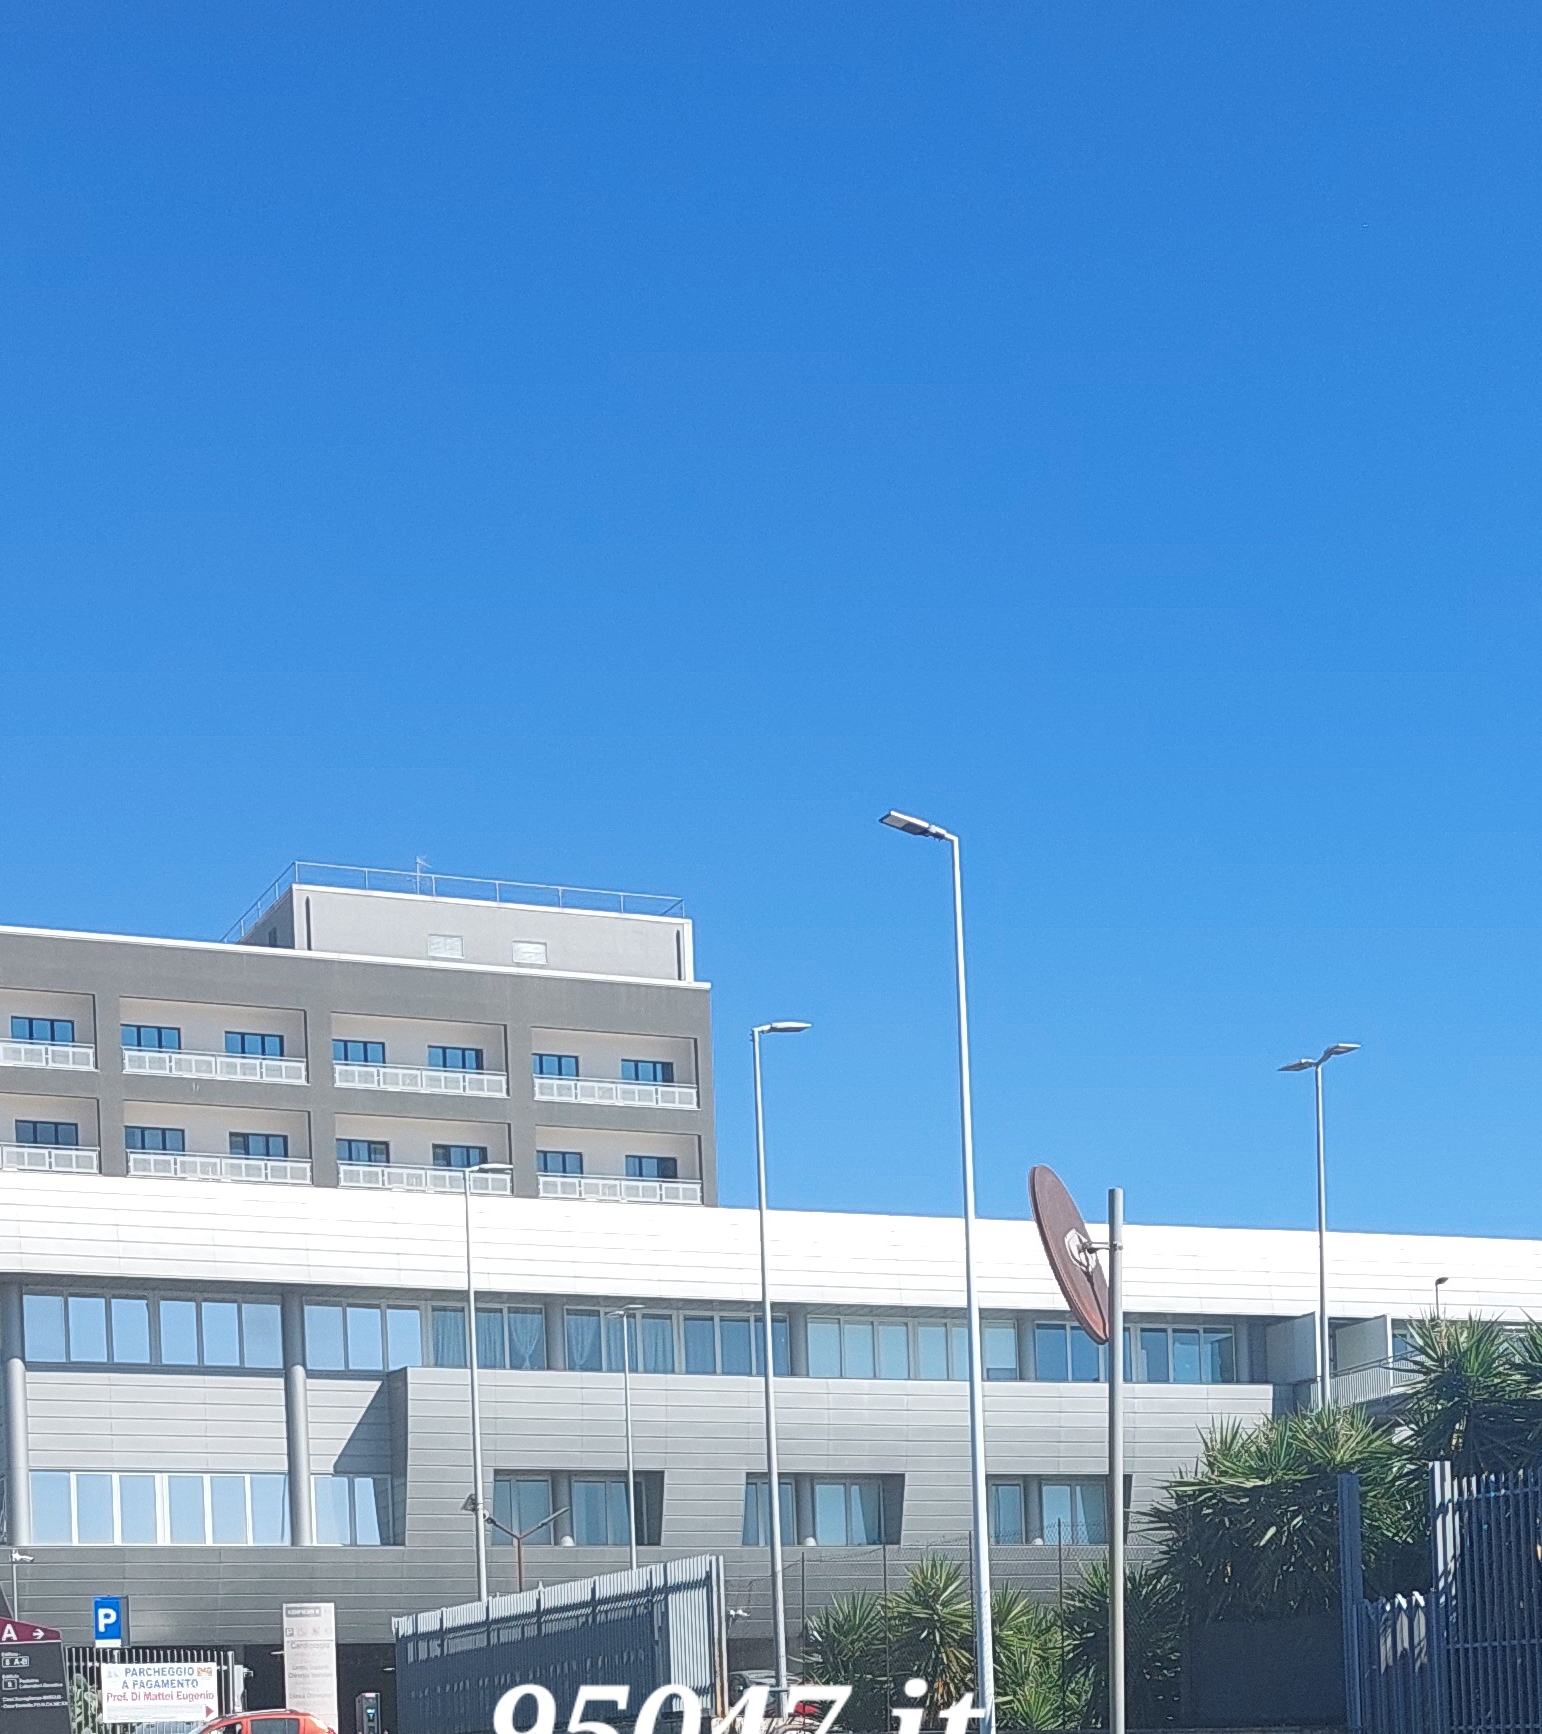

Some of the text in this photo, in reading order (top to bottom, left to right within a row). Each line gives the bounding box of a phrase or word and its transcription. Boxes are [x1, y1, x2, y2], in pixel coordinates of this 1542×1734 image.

[97, 1607, 117, 1633] P
[1, 1623, 18, 1641] A
[124, 1666, 195, 1677] PARCHEGGIO
[121, 1678, 199, 1690] A PAGAMENTO
[106, 1692, 128, 1702] Prof.
[143, 1691, 174, 1701] Mattei
[176, 1690, 215, 1702] Eugenio
